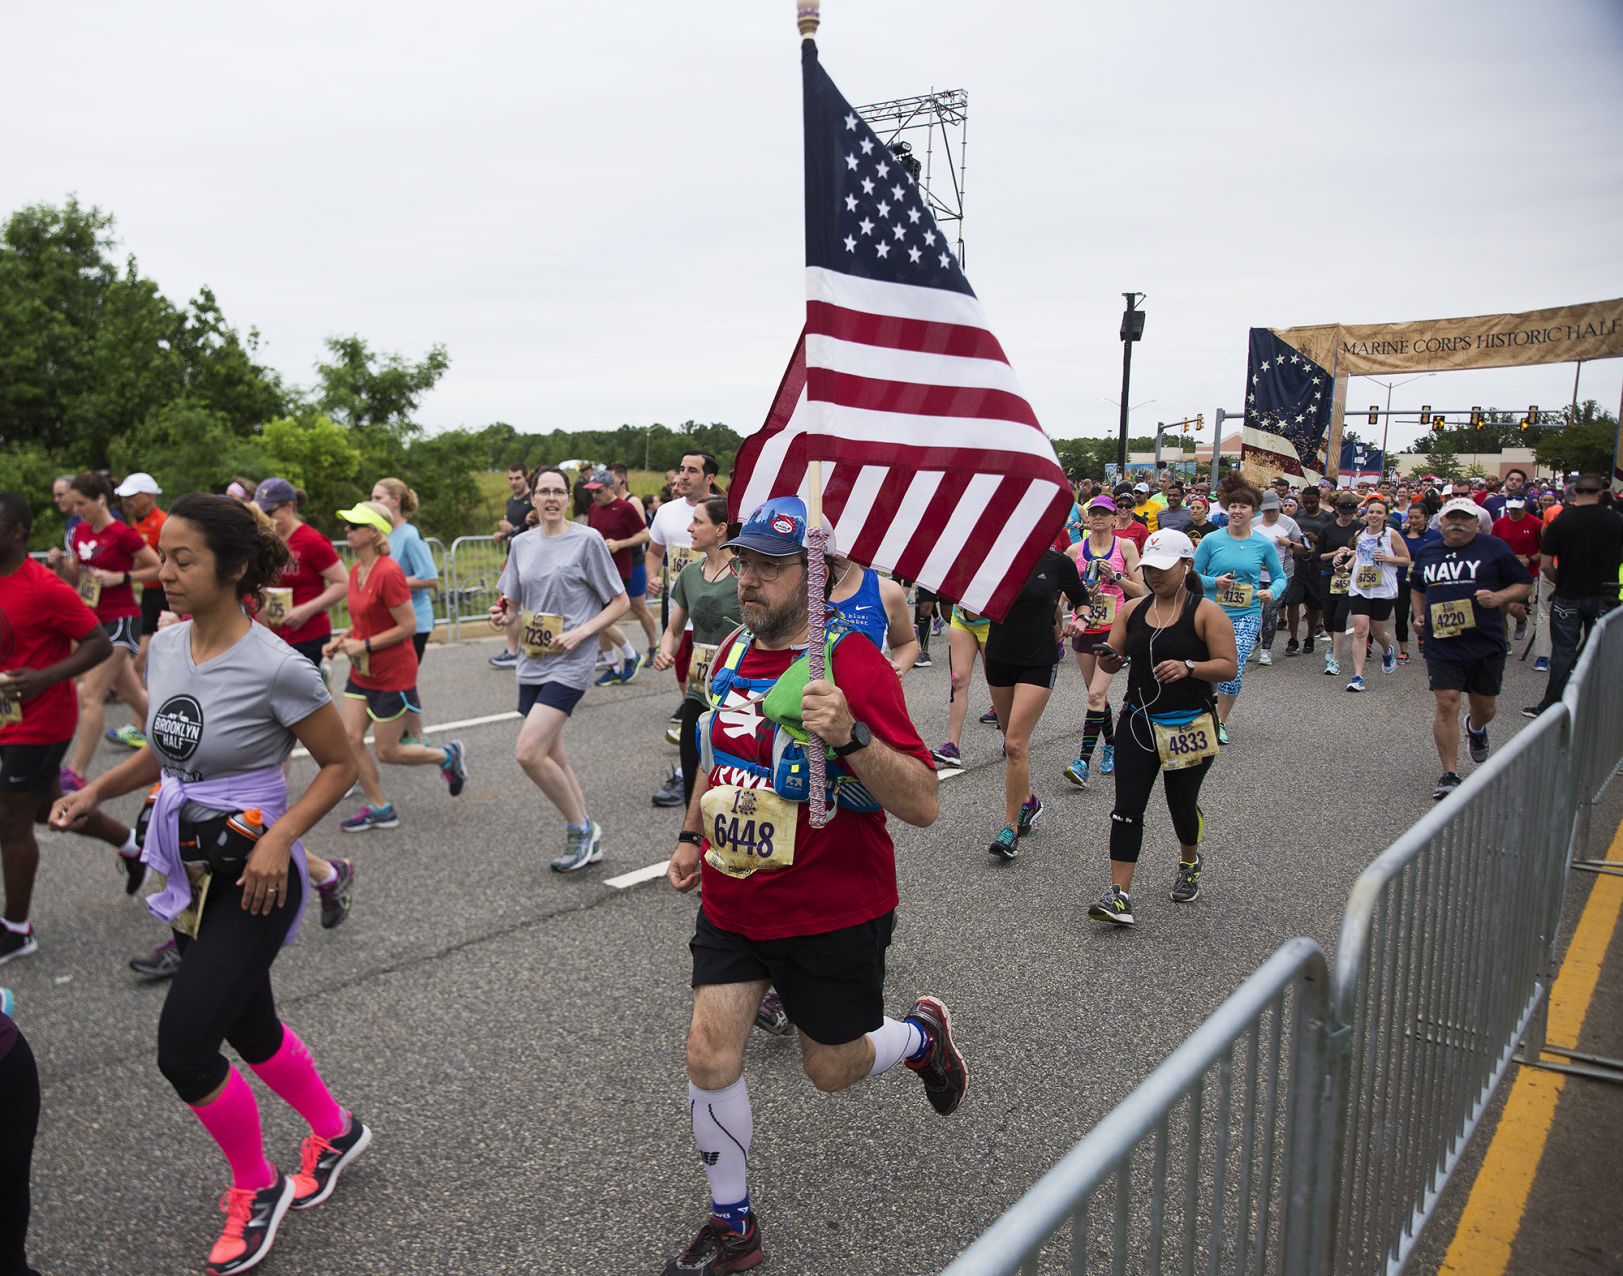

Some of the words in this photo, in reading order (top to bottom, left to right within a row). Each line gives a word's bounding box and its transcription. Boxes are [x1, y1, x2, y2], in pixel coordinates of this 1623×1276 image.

[1343, 340, 1409, 355] MARINE
[1413, 335, 1472, 354] CORPS
[1476, 326, 1562, 349] HISTORIC
[1566, 318, 1623, 340] HALF
[1423, 559, 1481, 584] NAVY
[1223, 590, 1245, 605] 4135
[1438, 611, 1465, 628] 4220
[525, 625, 552, 648] 7239
[154, 717, 200, 740] BROOKLYN
[163, 733, 184, 750] HALF
[1169, 730, 1208, 756] 4833
[714, 813, 775, 858] 6448
